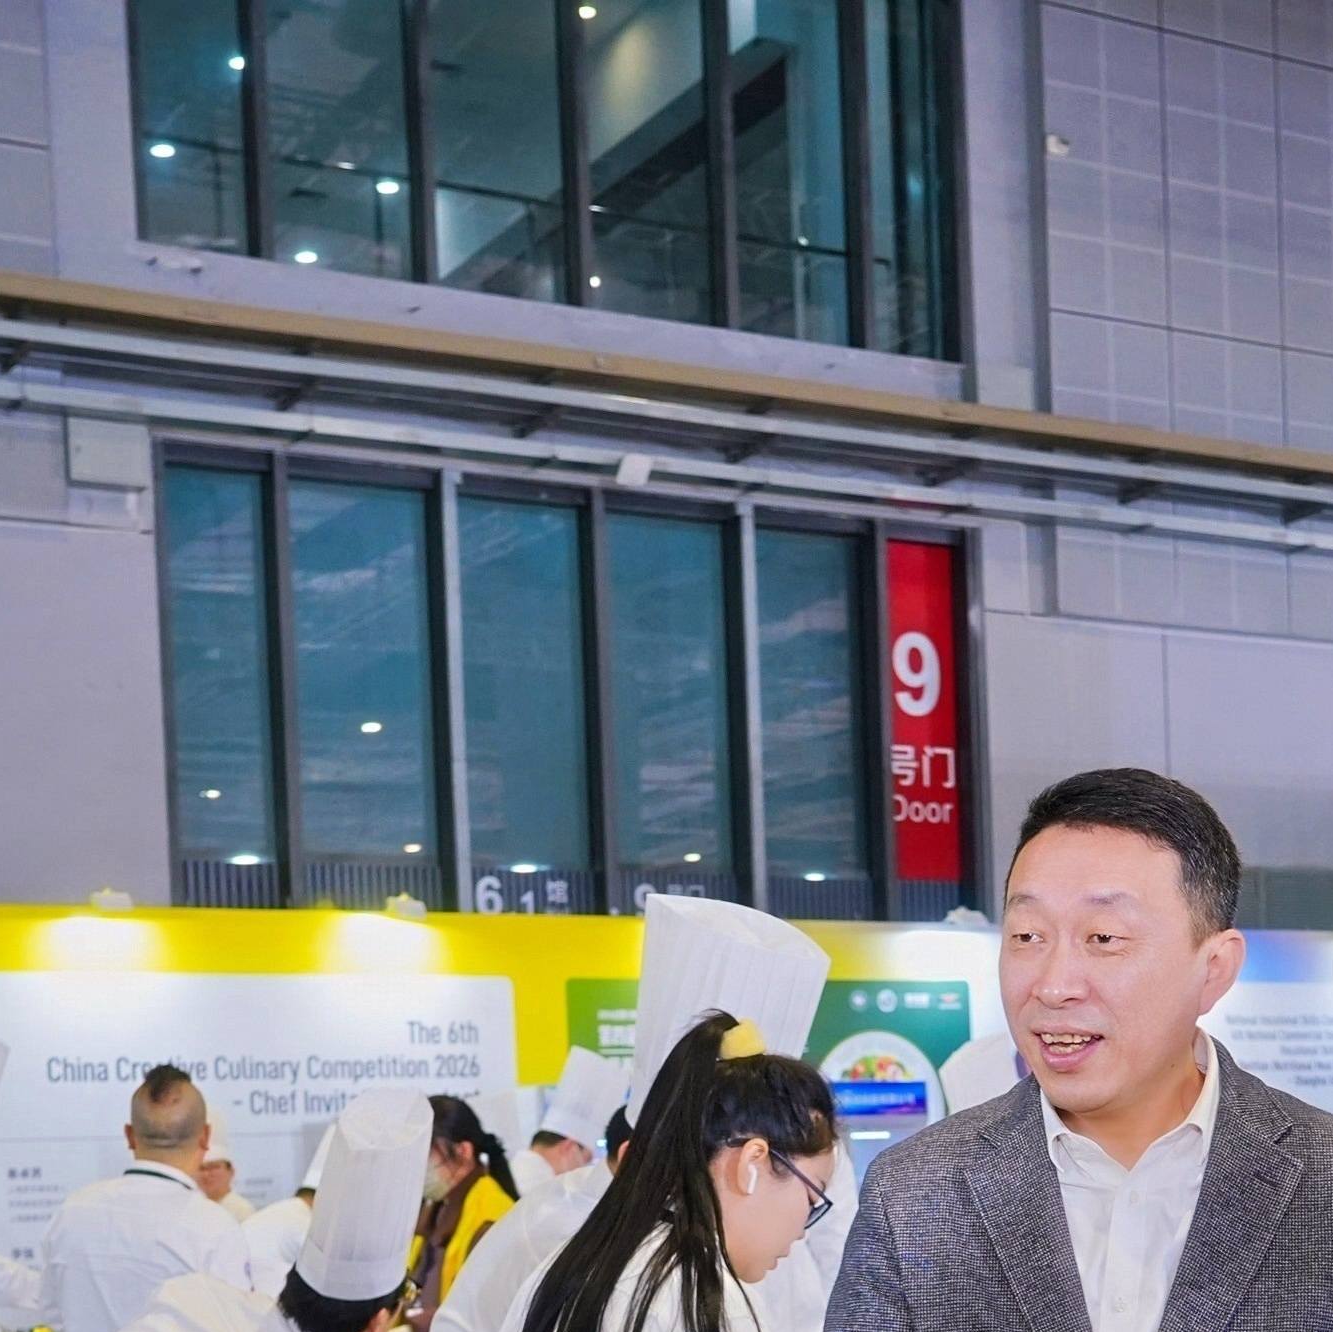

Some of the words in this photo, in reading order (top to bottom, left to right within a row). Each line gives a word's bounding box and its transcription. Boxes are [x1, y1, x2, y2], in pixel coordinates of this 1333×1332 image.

[892, 631, 941, 717] 9
[891, 744, 956, 788] 号门
[407, 1021, 442, 1045] The
[447, 1020, 479, 1045] 6th
[46, 1056, 109, 1083] China
[214, 1055, 301, 1086] Culinary
[306, 1054, 429, 1084] Competition
[434, 1053, 481, 1079] 2026
[250, 1090, 297, 1115] Chef
